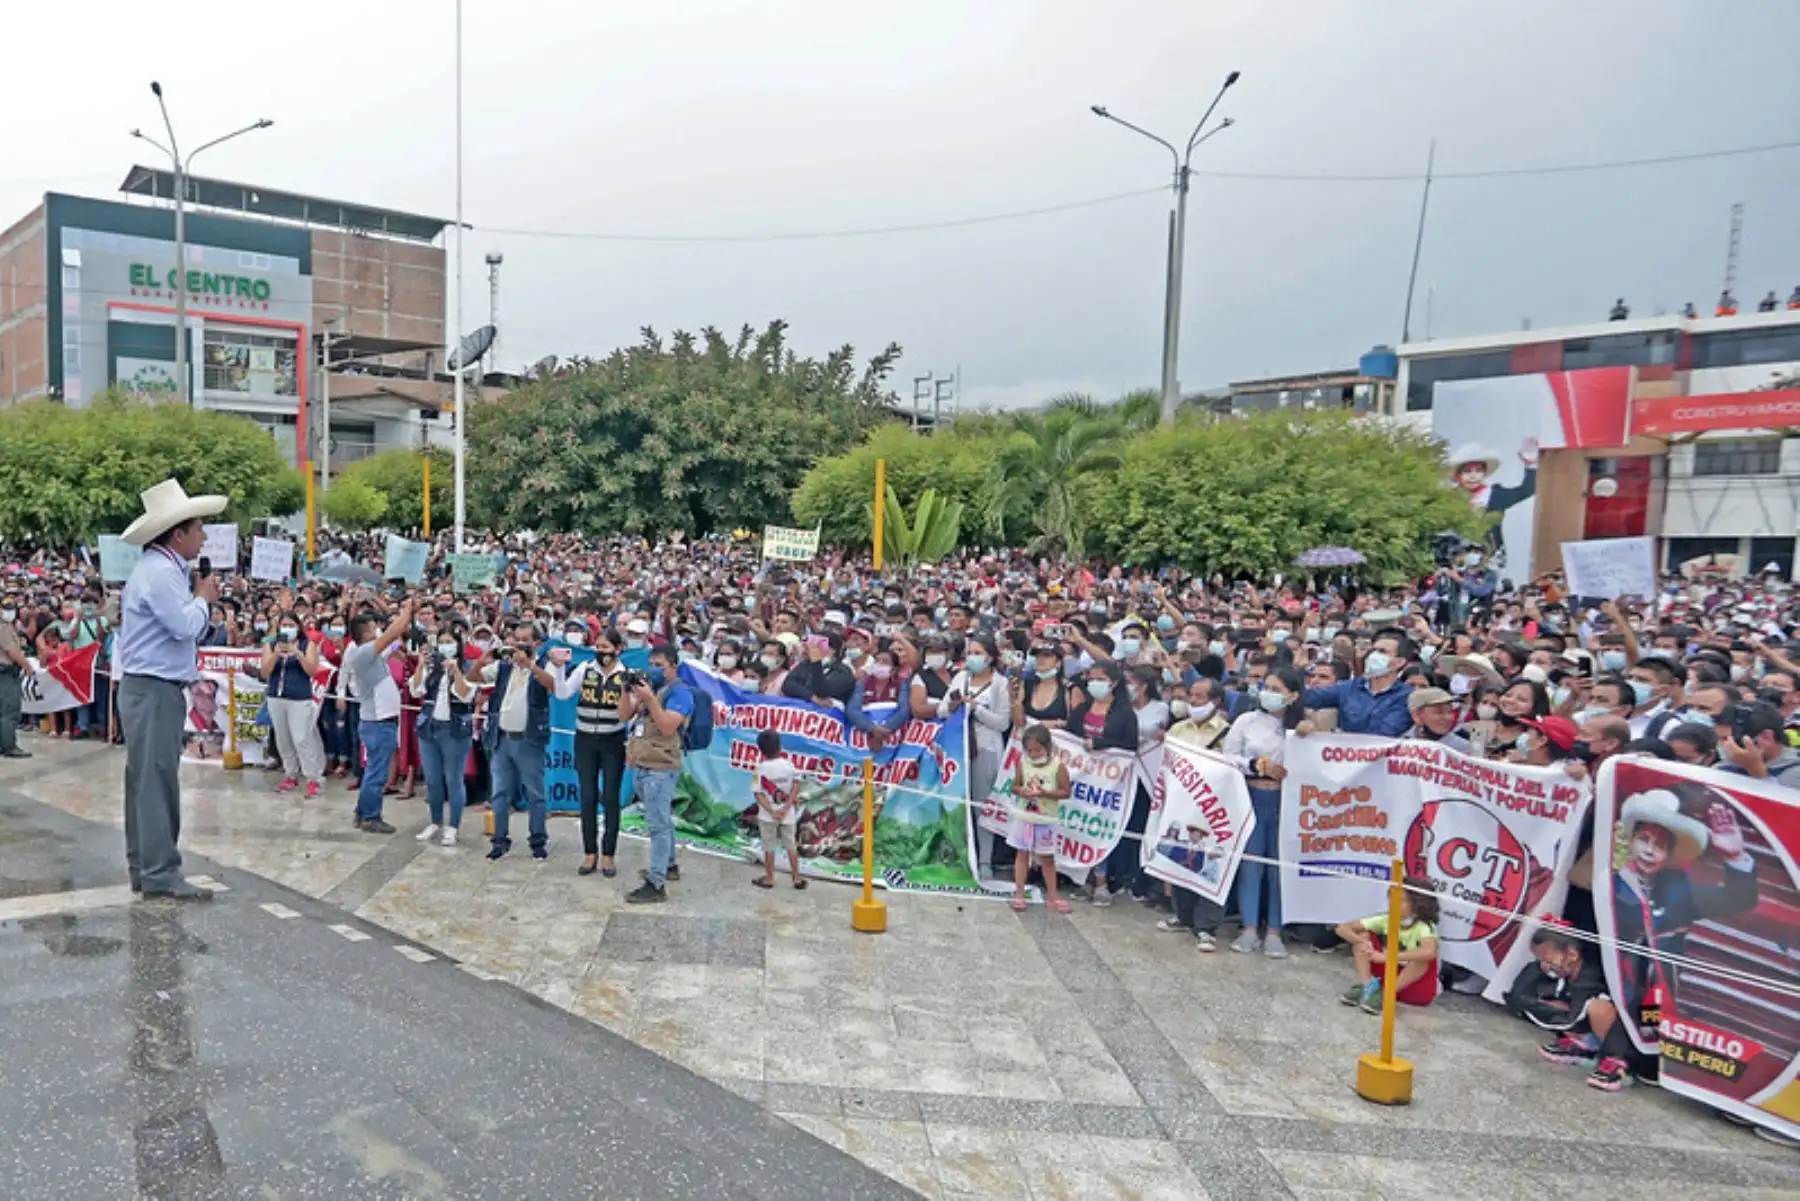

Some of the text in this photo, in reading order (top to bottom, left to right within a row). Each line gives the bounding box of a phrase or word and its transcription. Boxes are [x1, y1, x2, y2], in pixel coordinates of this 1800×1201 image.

[129, 263, 160, 288] EL
[731, 705, 844, 744] PROVINCIAL
[1300, 785, 1372, 808] Pedro
[1387, 758, 1568, 824] MAGISTERIAL Y POPULAR
[1514, 776, 1547, 799] DEL
[1299, 805, 1388, 831] Castillo
[1687, 1050, 1737, 1078] PERÚ
